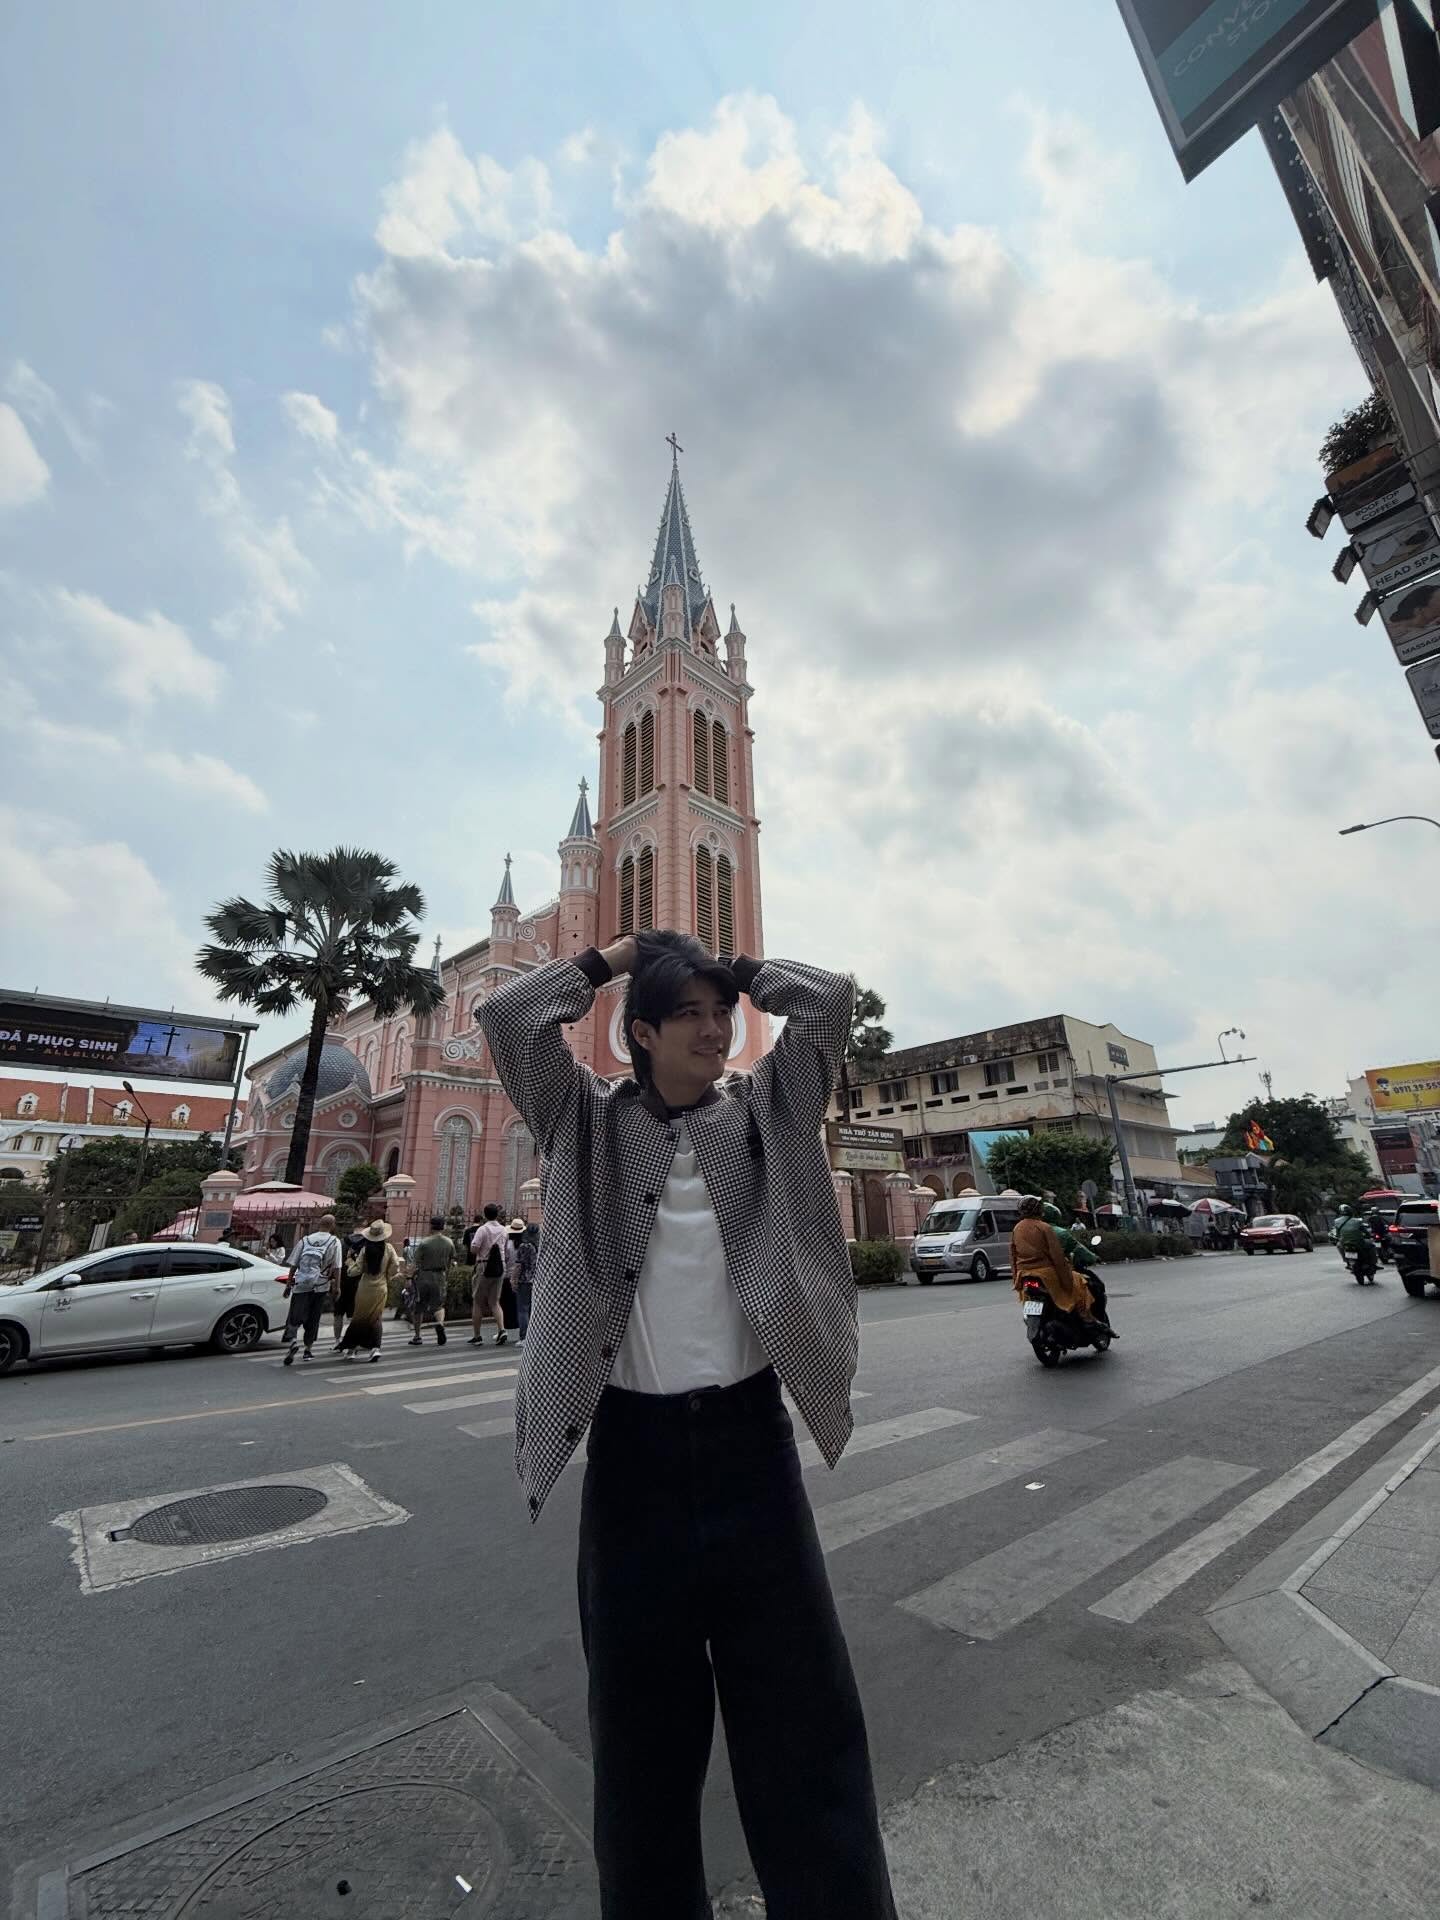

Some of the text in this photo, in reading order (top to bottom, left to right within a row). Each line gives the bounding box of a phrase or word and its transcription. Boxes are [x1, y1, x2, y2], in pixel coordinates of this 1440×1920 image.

[1227, 0, 1281, 47] STO
[1355, 490, 1400, 517] ROOF TOP
[1361, 499, 1400, 521] COFFEE
[1375, 552, 1439, 586] HEAD SPA
[0, 1029, 118, 1052] ĐÃ PHỤC SINH
[43, 1048, 115, 1061] ALLELUIA
